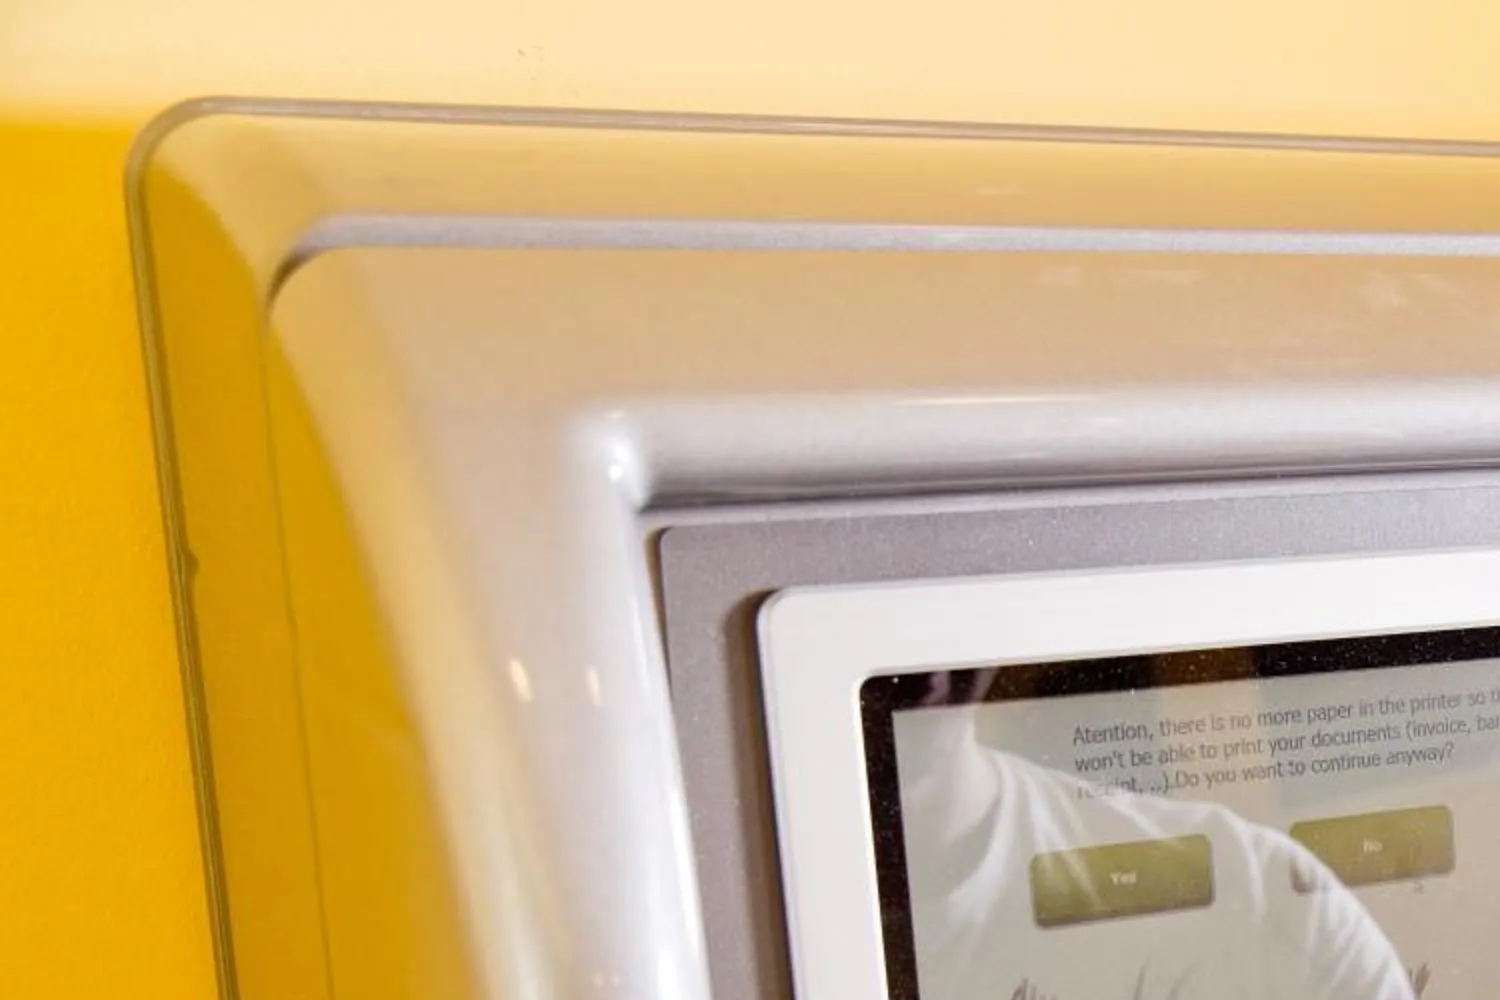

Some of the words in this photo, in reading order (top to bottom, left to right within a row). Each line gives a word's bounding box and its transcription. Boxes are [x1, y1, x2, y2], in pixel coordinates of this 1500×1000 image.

[1073, 721, 1154, 747] Atention,
[1159, 717, 1206, 737] there
[1210, 712, 1227, 732] is
[1230, 712, 1252, 732] no
[1257, 708, 1302, 728] more
[1306, 704, 1354, 726] paper
[1359, 698, 1374, 717] in
[1379, 694, 1406, 715] the
[1409, 690, 1462, 718] printer
[1467, 690, 1486, 708] so
[1075, 748, 1127, 773] won't
[1130, 746, 1153, 767] be
[1158, 742, 1196, 765] able
[1200, 742, 1218, 760] to
[1222, 735, 1264, 762] print
[1267, 735, 1307, 758] your
[1310, 724, 1401, 748] documents
[1405, 716, 1471, 743] (invoice,
[1203, 768, 1238, 791] you
[1241, 761, 1285, 782] want
[1286, 758, 1306, 777] to
[1311, 752, 1382, 775] continue
[1386, 740, 1455, 767] anyway?
[1362, 838, 1384, 854] No
